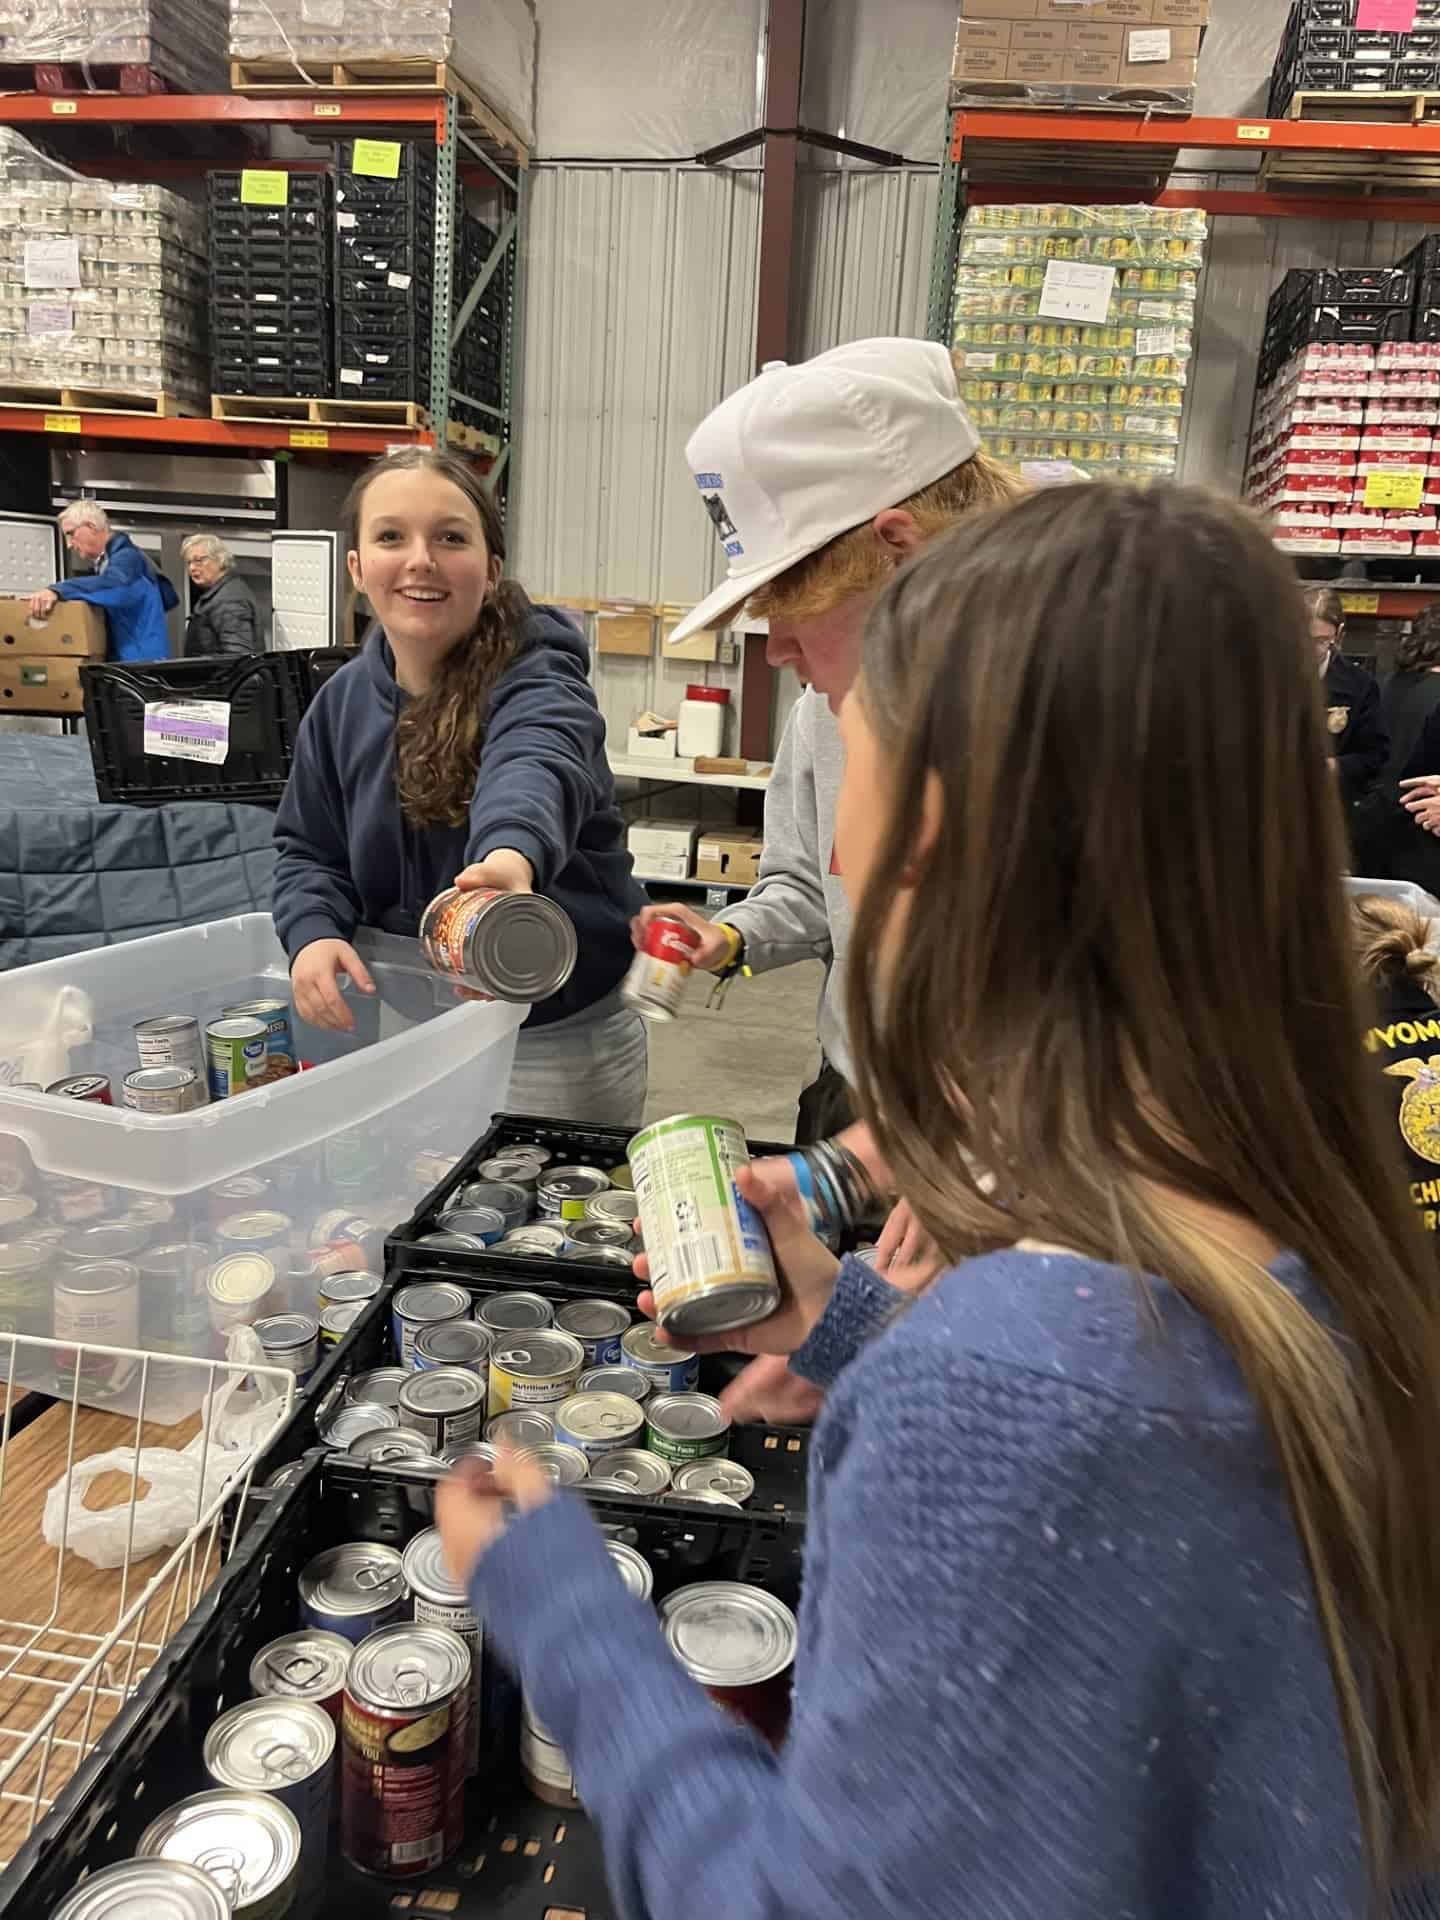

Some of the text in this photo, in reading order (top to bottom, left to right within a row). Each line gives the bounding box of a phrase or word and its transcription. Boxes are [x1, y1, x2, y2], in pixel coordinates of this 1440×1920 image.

[1423, 1210, 1440, 1231] R
[512, 1381, 549, 1391] Nutrition
[417, 1600, 452, 1618] Nutrition
